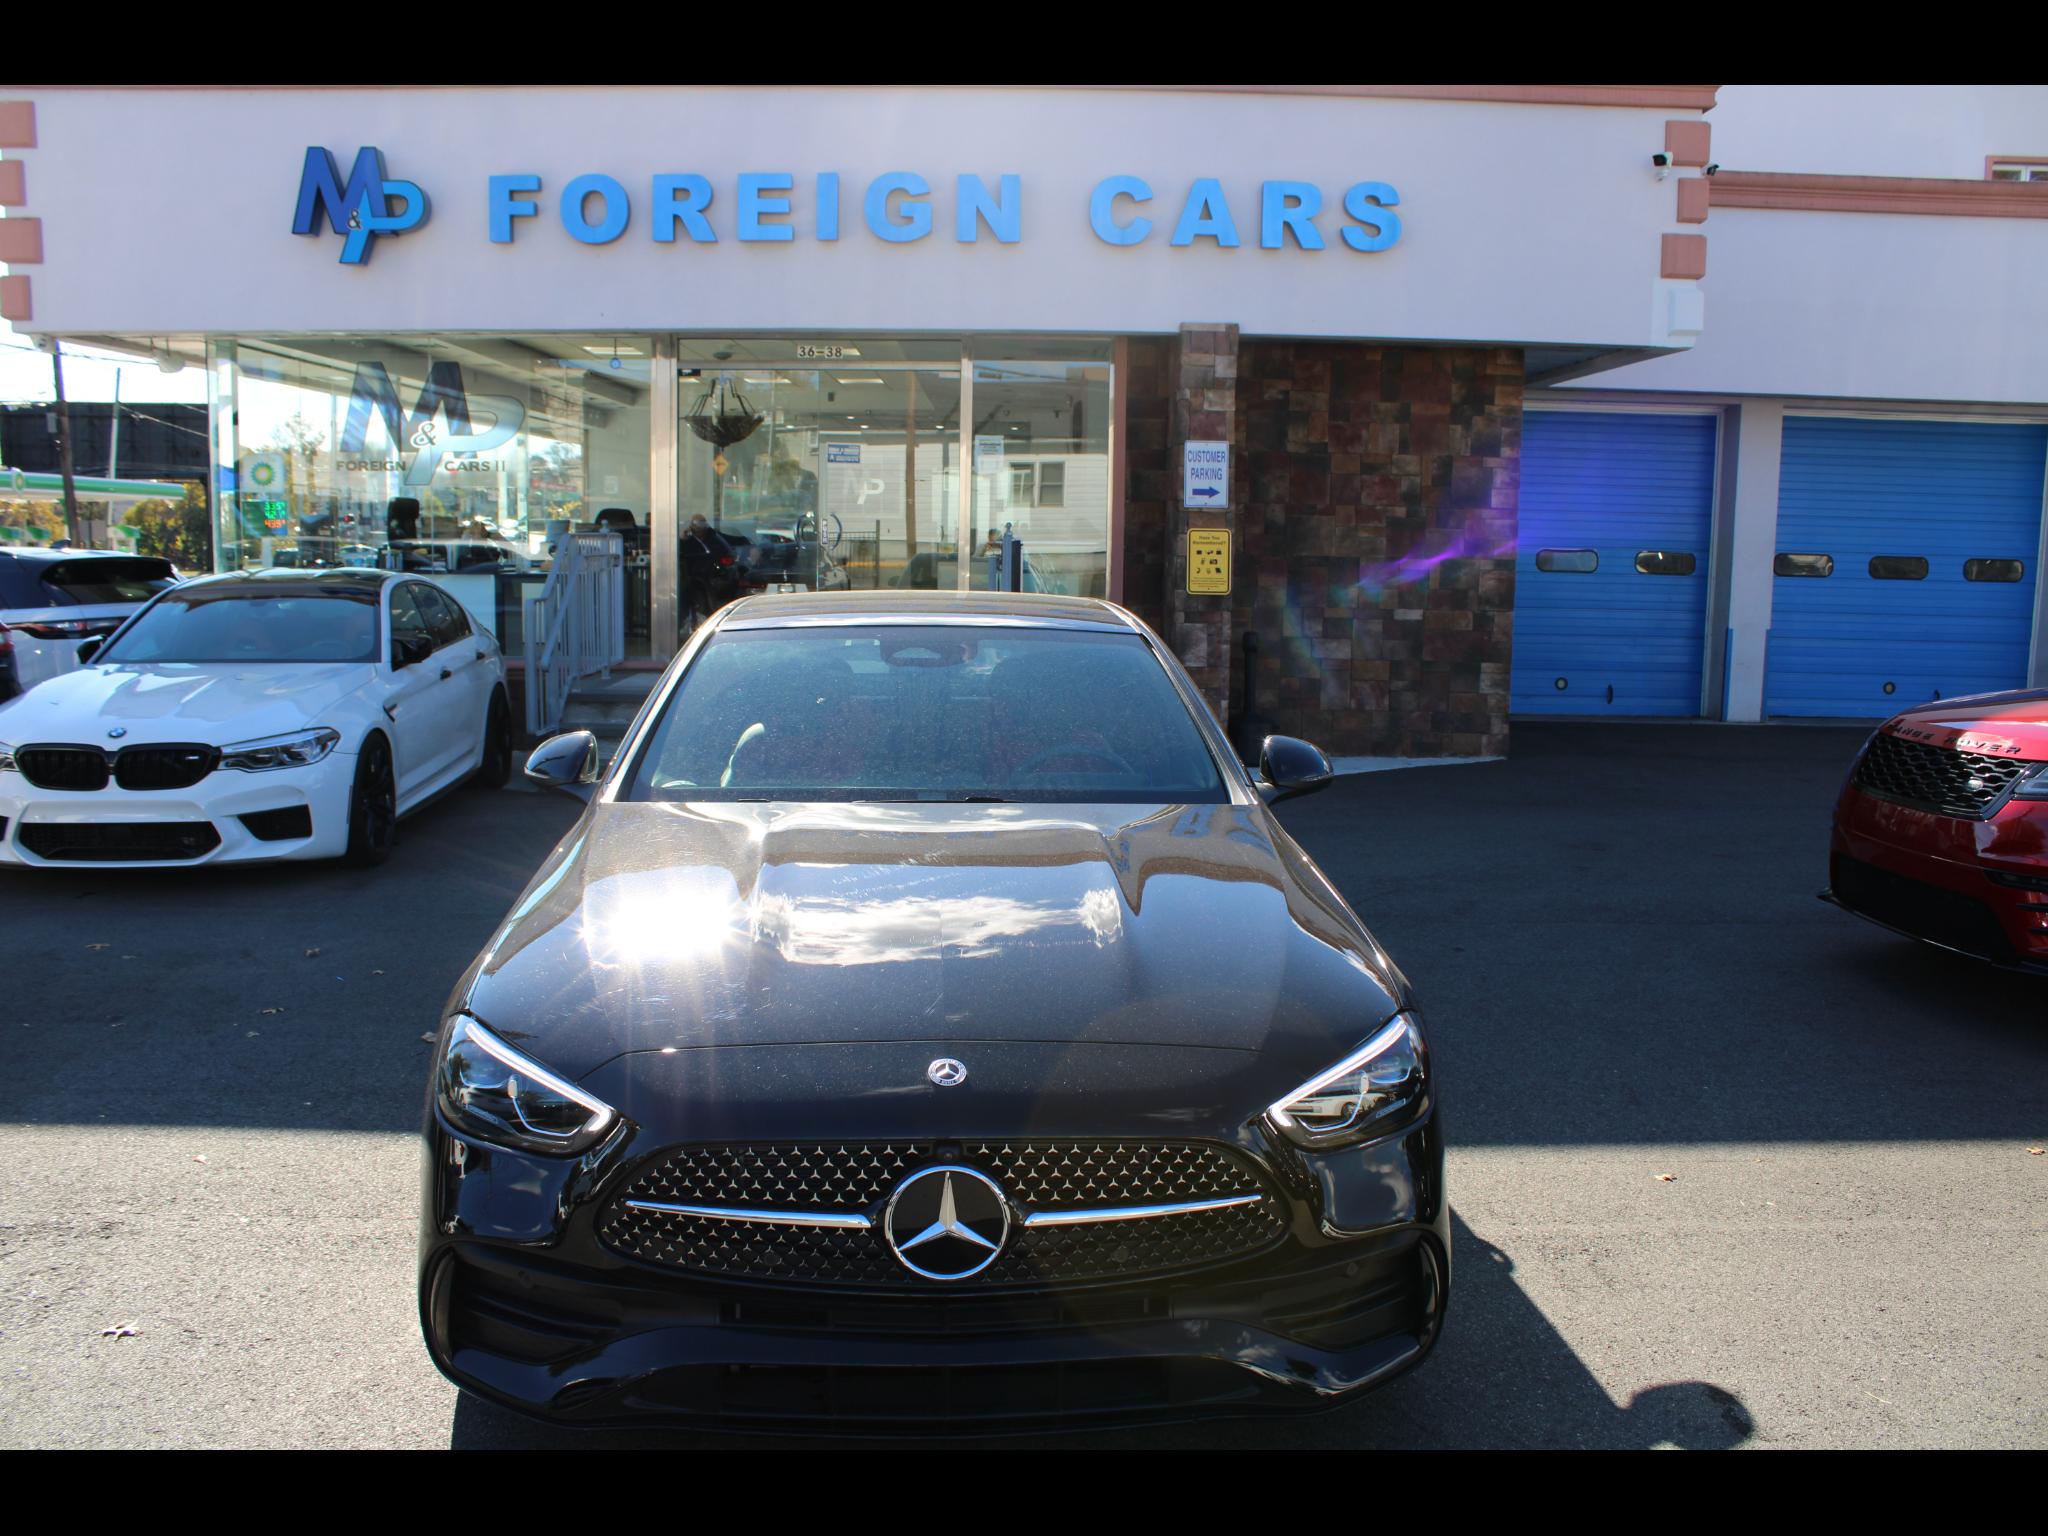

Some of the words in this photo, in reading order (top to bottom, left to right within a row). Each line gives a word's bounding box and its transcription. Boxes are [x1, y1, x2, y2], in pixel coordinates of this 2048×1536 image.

[488, 172, 1021, 245] FOREIGN
[1089, 174, 1401, 252] CARS
[799, 346, 842, 358] 36-38
[1187, 450, 1226, 463] CUSTOMER
[336, 461, 406, 472] FOREIGN
[444, 461, 490, 472] CARS
[1190, 468, 1223, 480] PARKING
